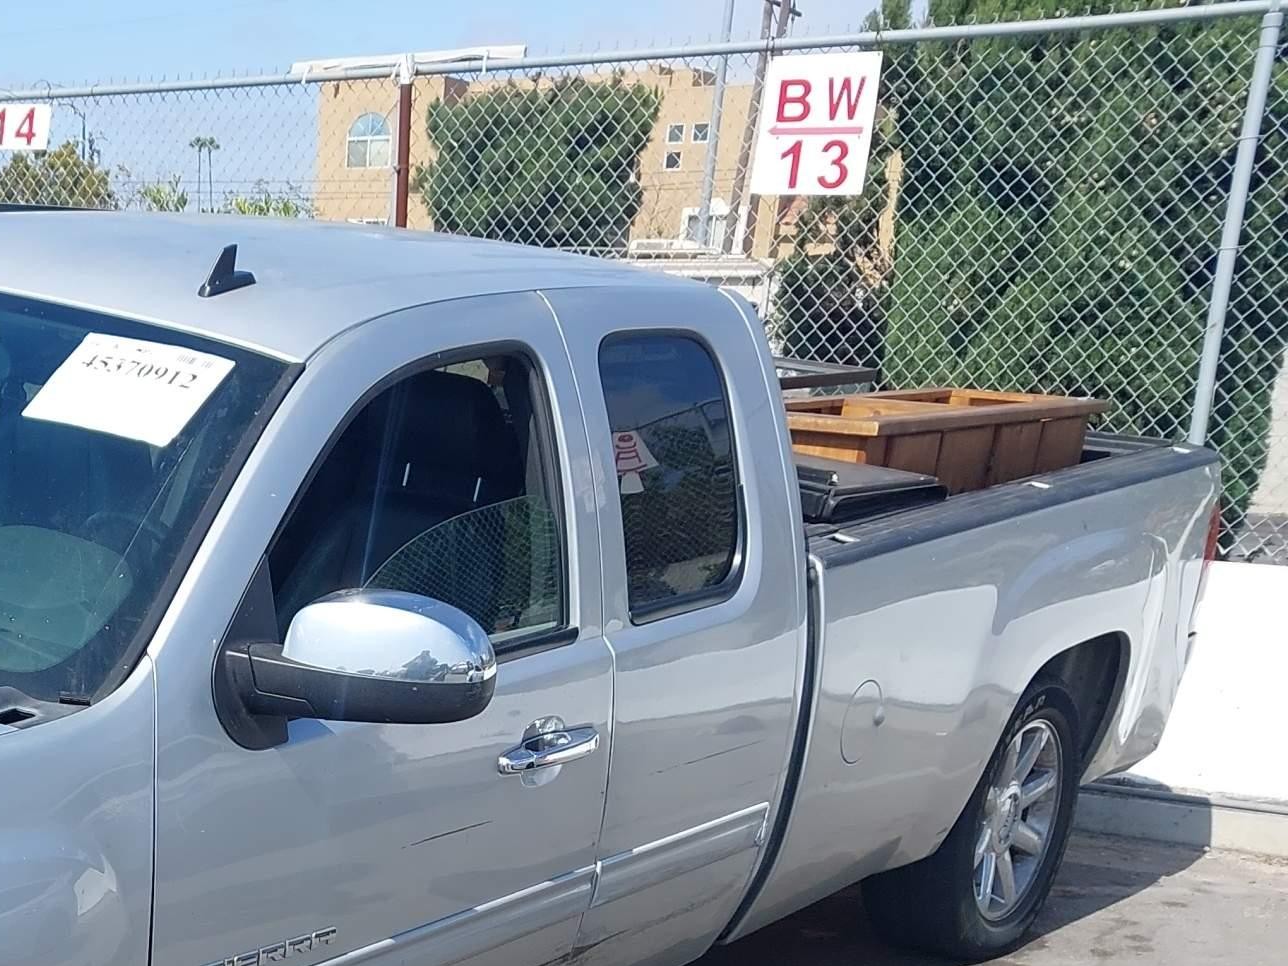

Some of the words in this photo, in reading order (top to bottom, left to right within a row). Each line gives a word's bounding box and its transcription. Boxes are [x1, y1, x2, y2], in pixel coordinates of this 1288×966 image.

[776, 76, 866, 122] BW
[780, 139, 849, 189] 13
[81, 354, 198, 389] 45370912
